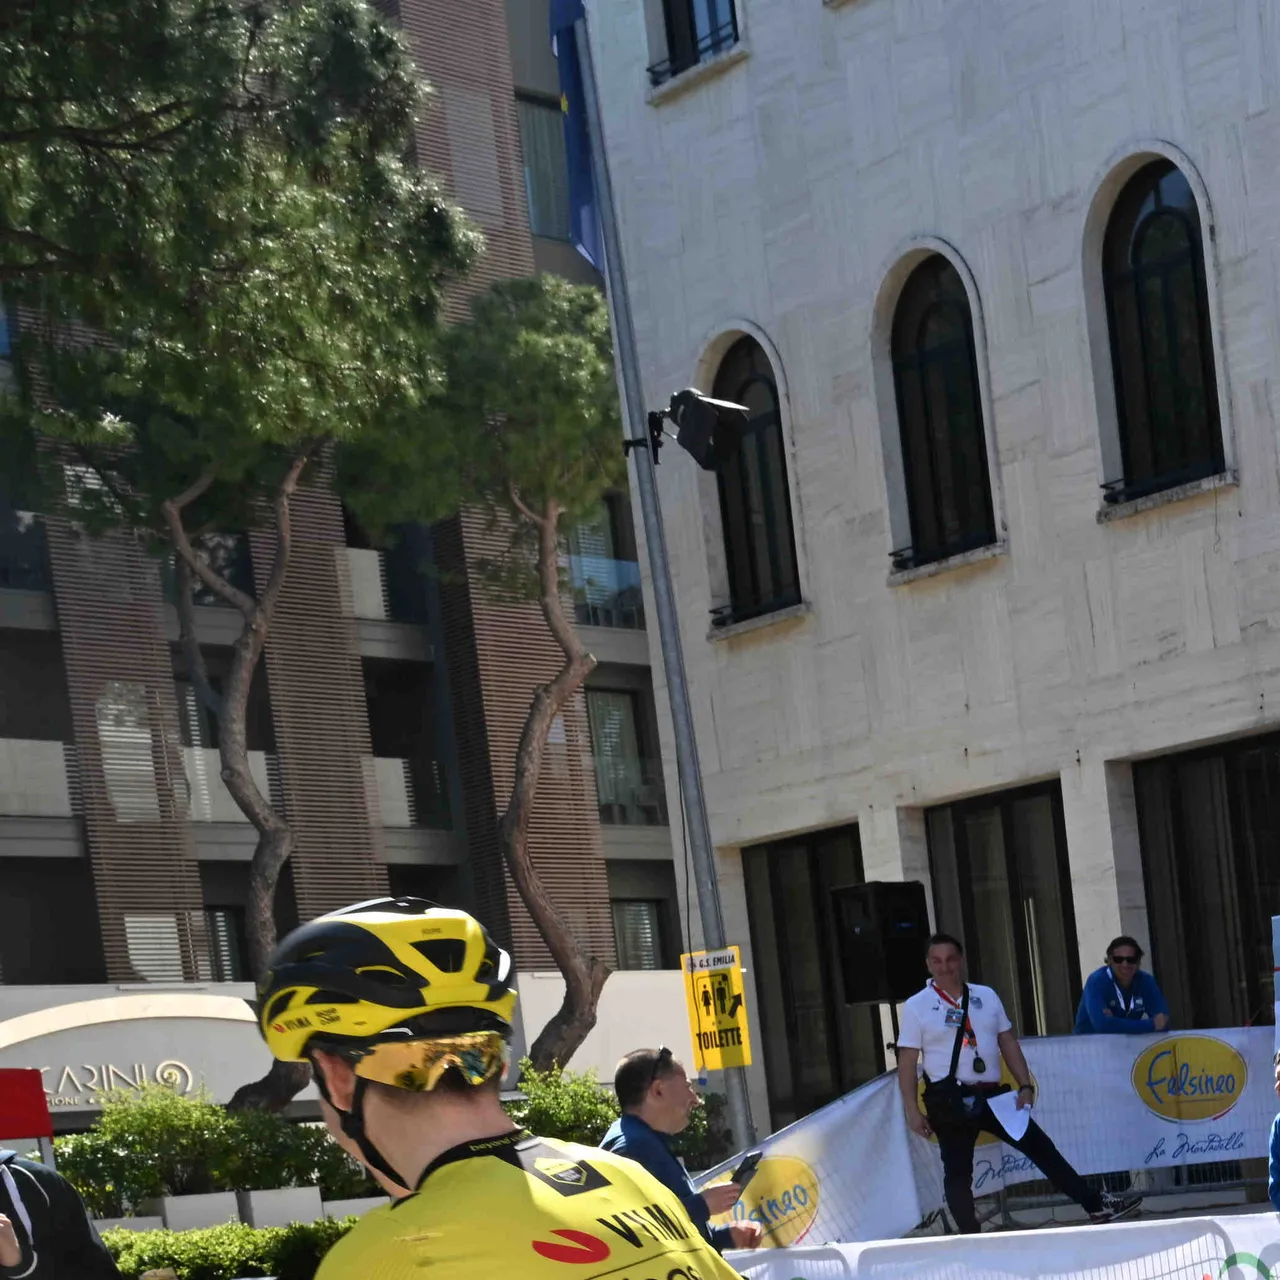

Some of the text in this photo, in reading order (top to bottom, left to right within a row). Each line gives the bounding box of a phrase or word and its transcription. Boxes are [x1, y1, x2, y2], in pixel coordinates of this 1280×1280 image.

[699, 954, 735, 968] G.S. EMILIA
[696, 1027, 742, 1050] TOILETTE
[1147, 1051, 1236, 1104] Felsineo
[1145, 1139, 1166, 1163] La
